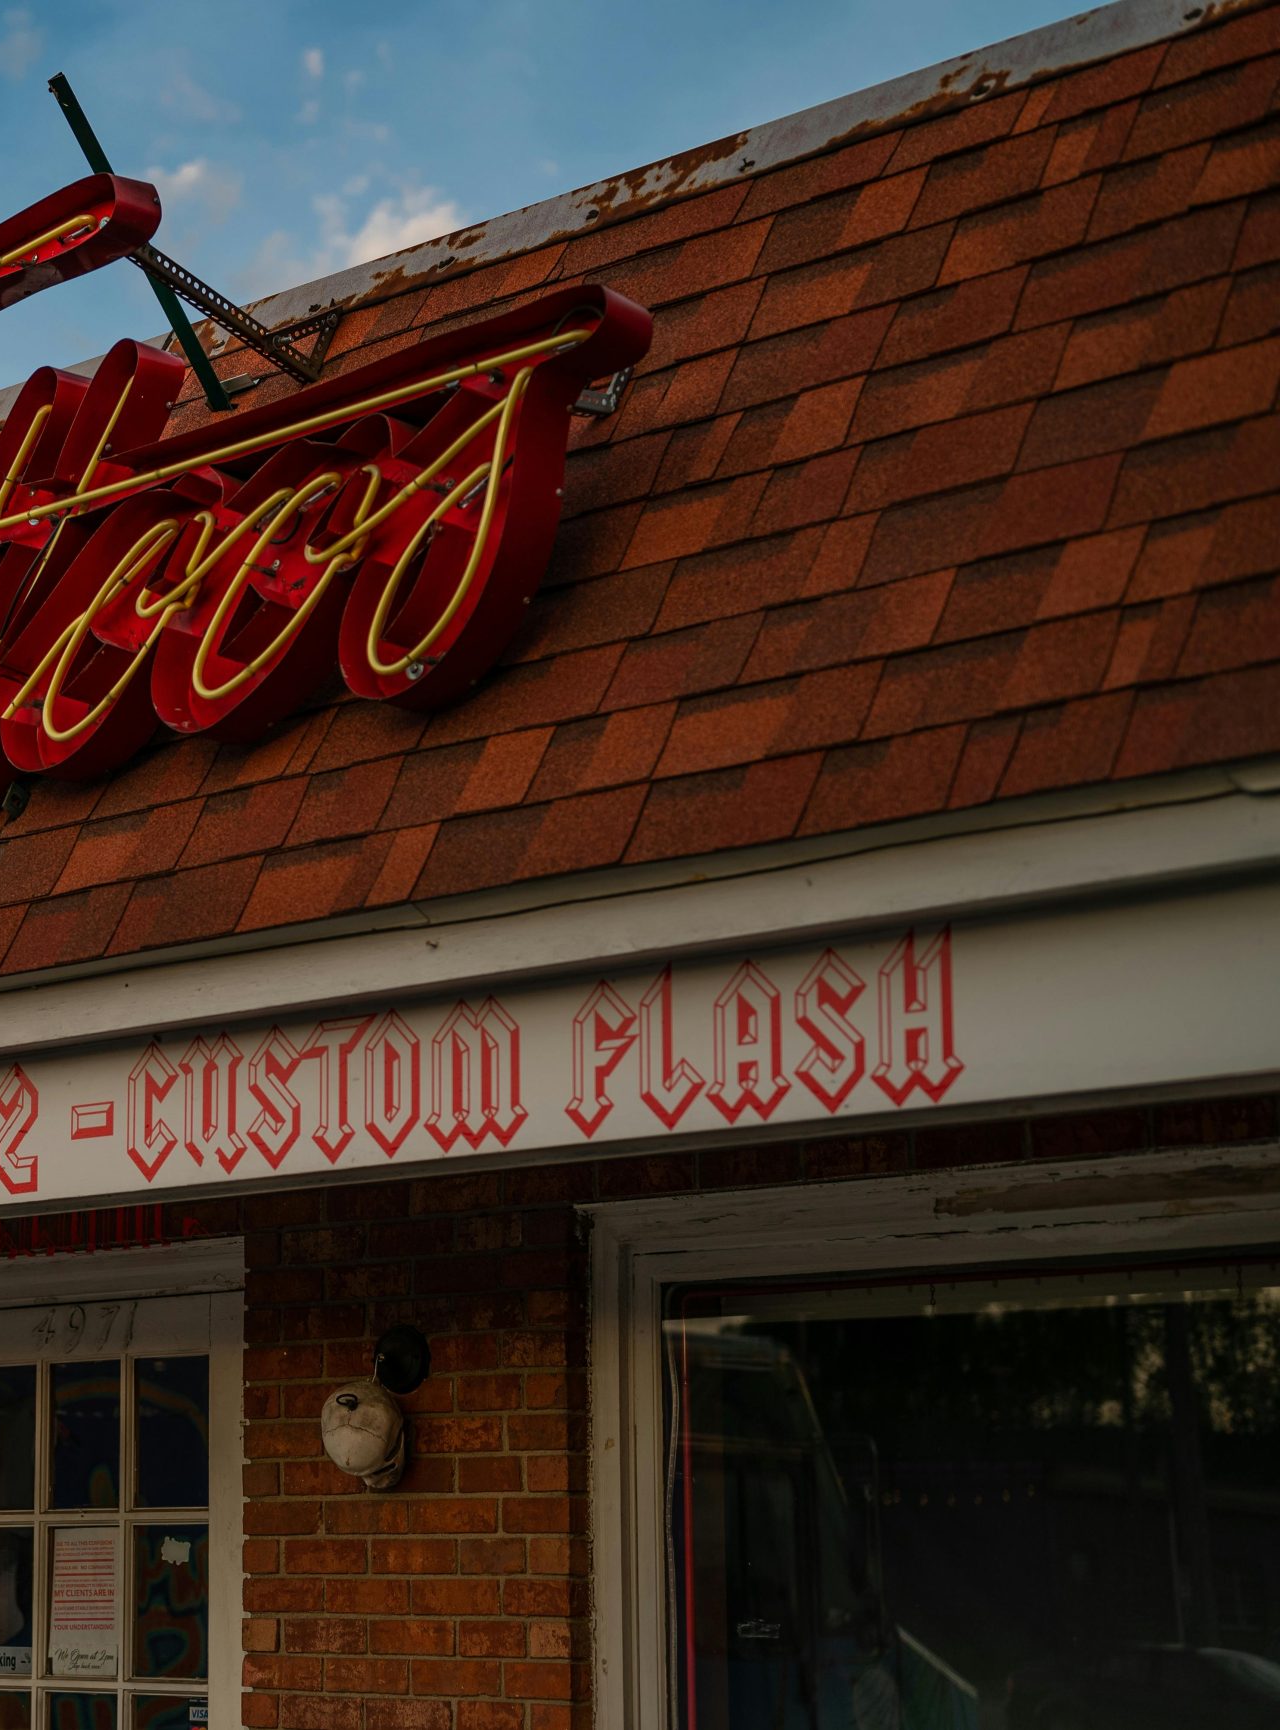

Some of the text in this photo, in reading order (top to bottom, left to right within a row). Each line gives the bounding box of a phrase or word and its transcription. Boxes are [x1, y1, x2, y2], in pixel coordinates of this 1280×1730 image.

[127, 994, 530, 1183] CUSTOM
[565, 921, 965, 1140] FLASH
[54, 1589, 65, 1598] MY
[65, 1589, 93, 1597] CLIENTS
[93, 1589, 106, 1597] ARE
[70, 1648, 89, 1665] Open
[191, 1709, 208, 1719] VISA
